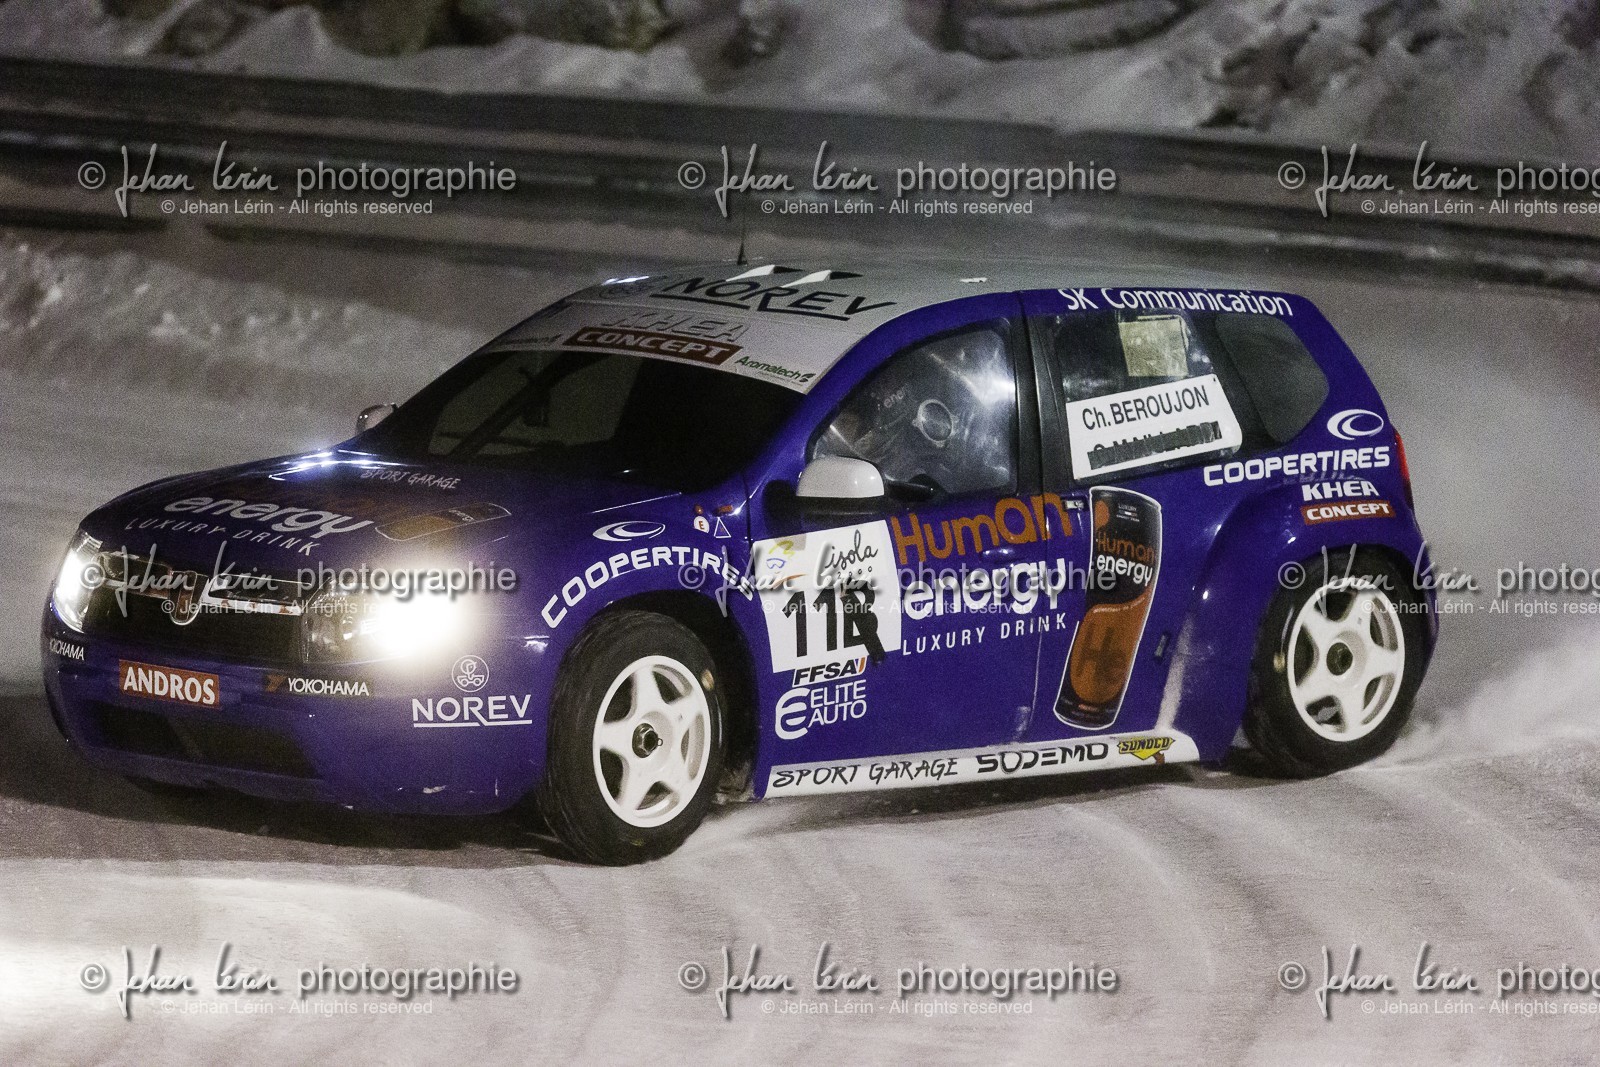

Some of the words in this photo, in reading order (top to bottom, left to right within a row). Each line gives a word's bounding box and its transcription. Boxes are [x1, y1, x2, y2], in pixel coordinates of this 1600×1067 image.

[656, 277, 898, 318] NOREV
[1058, 288, 1099, 311] SK
[1101, 288, 1293, 316] Communication
[576, 330, 731, 359] CONCEPT
[735, 356, 801, 379] Aromatech
[360, 469, 407, 484] SPORT
[408, 472, 461, 489] GARAGE
[1204, 446, 1390, 486] COOPERTIRES
[1302, 481, 1380, 502] KHEA
[164, 496, 374, 539] energy
[1306, 503, 1390, 521] CONCEPT
[125, 517, 227, 535] LUXURY
[234, 529, 322, 556] DRINK
[890, 492, 1073, 565] Human
[1097, 529, 1155, 561] Human
[1096, 554, 1153, 587] energy
[542, 546, 757, 628] COOPERTIRES
[904, 557, 1066, 620] energy
[903, 627, 985, 656] LUXURY
[1001, 612, 1067, 639] DRINK
[123, 666, 216, 705] ANDROS
[287, 677, 370, 697] YOKOHAMA
[794, 660, 858, 686] FFSA
[412, 694, 532, 725] NOREV
[808, 700, 867, 728] AUTO
[1121, 737, 1170, 752] SUNOCO
[773, 764, 862, 788] SPORT
[869, 757, 958, 784] GARAGE
[977, 743, 1109, 775] SODEMO
